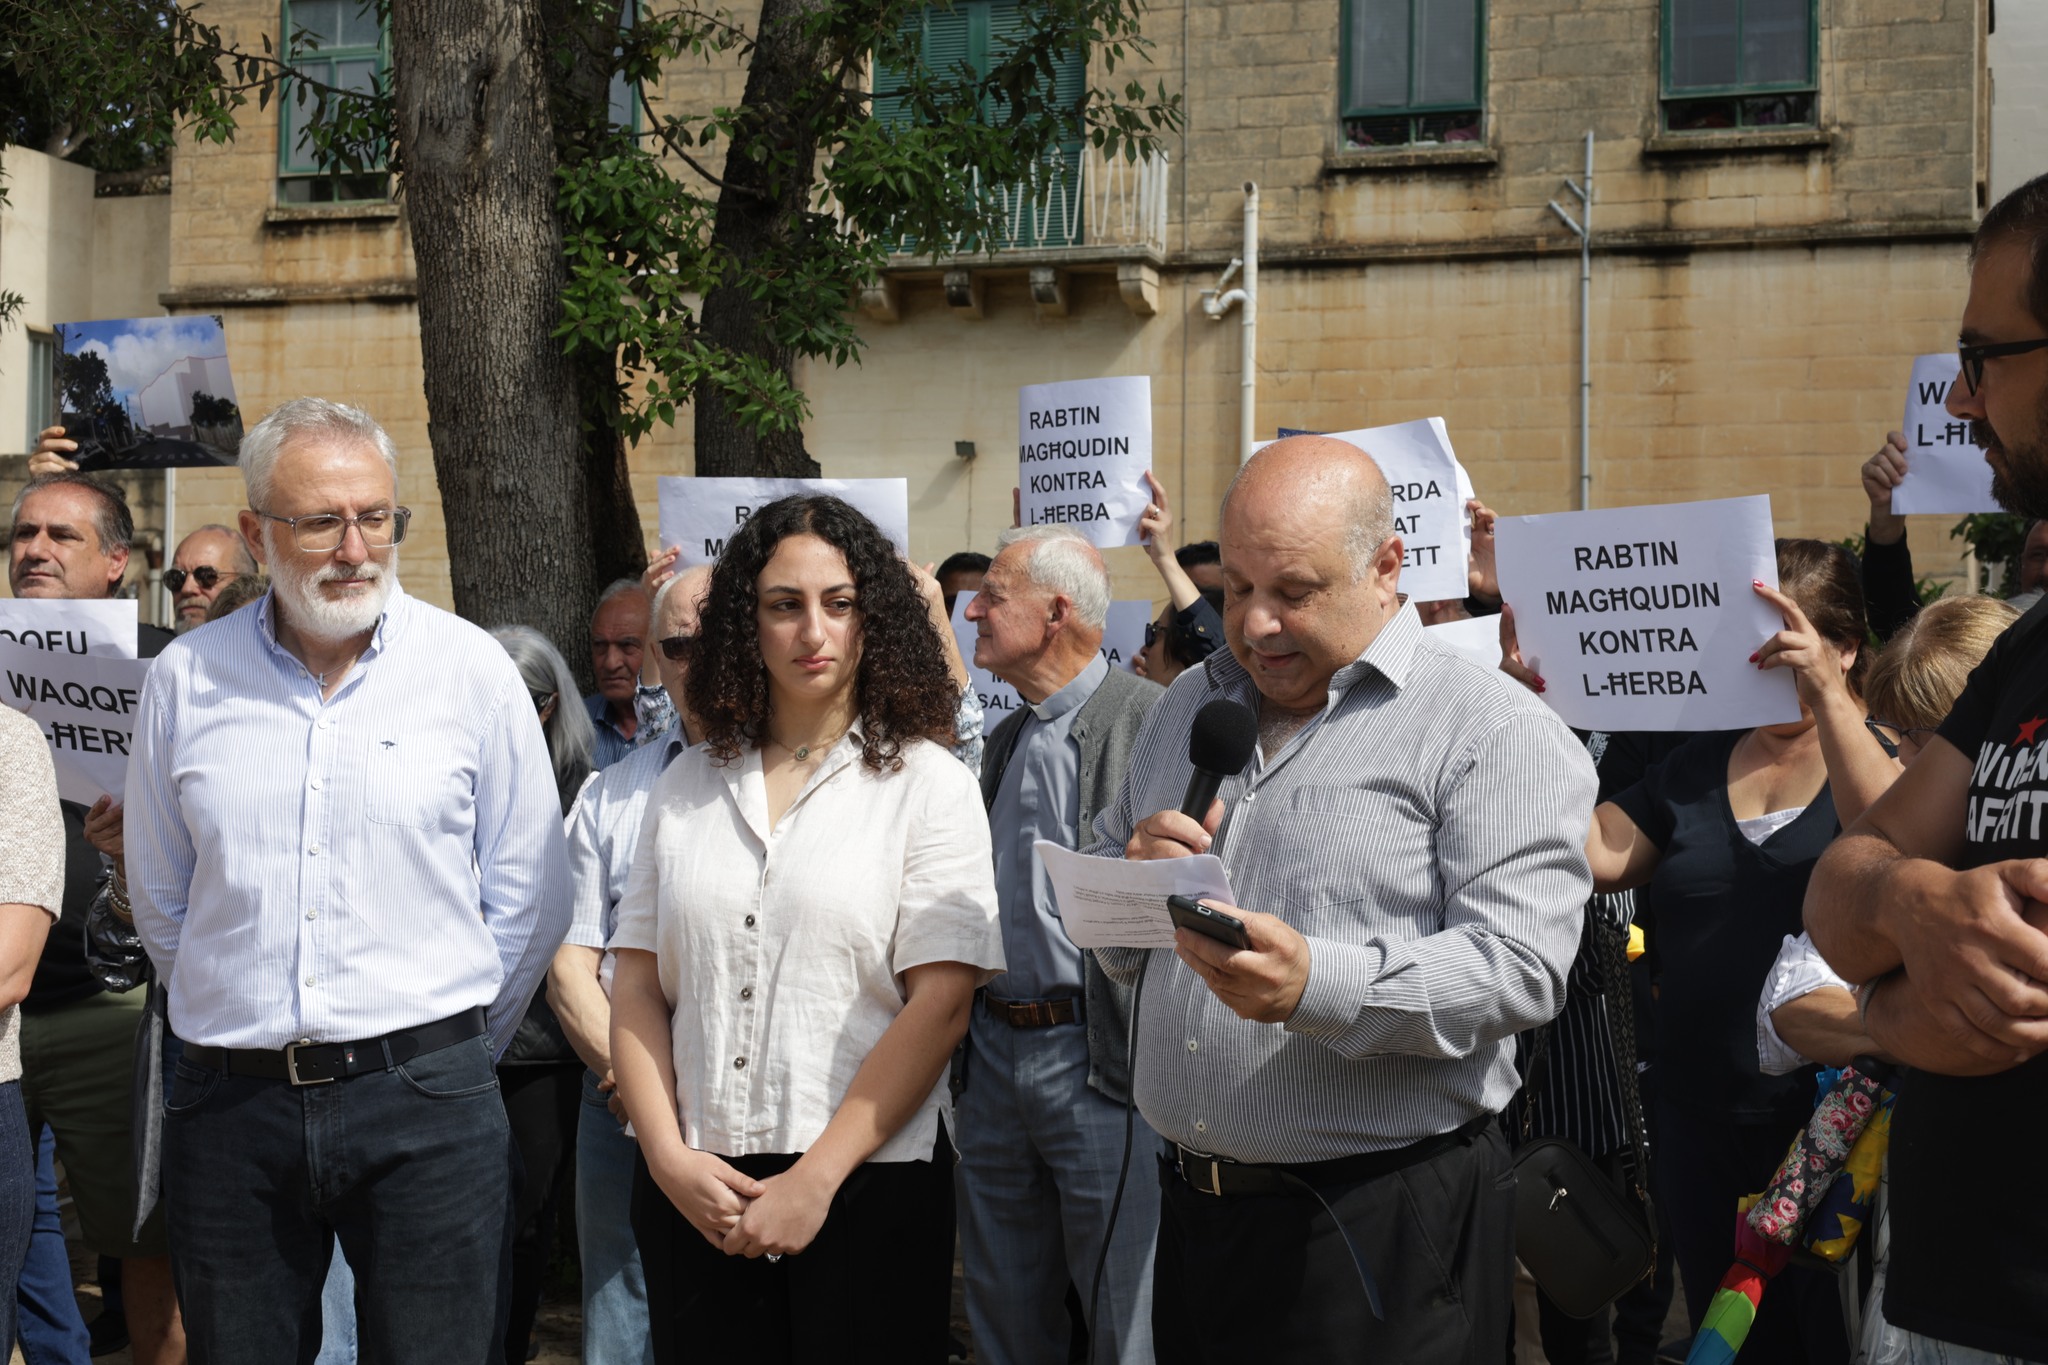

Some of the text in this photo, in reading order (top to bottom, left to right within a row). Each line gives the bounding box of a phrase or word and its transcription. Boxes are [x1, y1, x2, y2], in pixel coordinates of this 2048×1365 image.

[1029, 405, 1100, 430] RABTIN
[1030, 470, 1107, 494] KONTRA
[1030, 502, 1110, 525] L-ĦERBA
[1574, 540, 1679, 572] RABTIN
[1546, 582, 1721, 616] MAGĦQUDIN
[1578, 627, 1699, 655] KONTRA
[6, 669, 142, 715] WAQQF
[1582, 670, 1708, 697] L-ĦERBA
[45, 721, 132, 756] -ĦER
